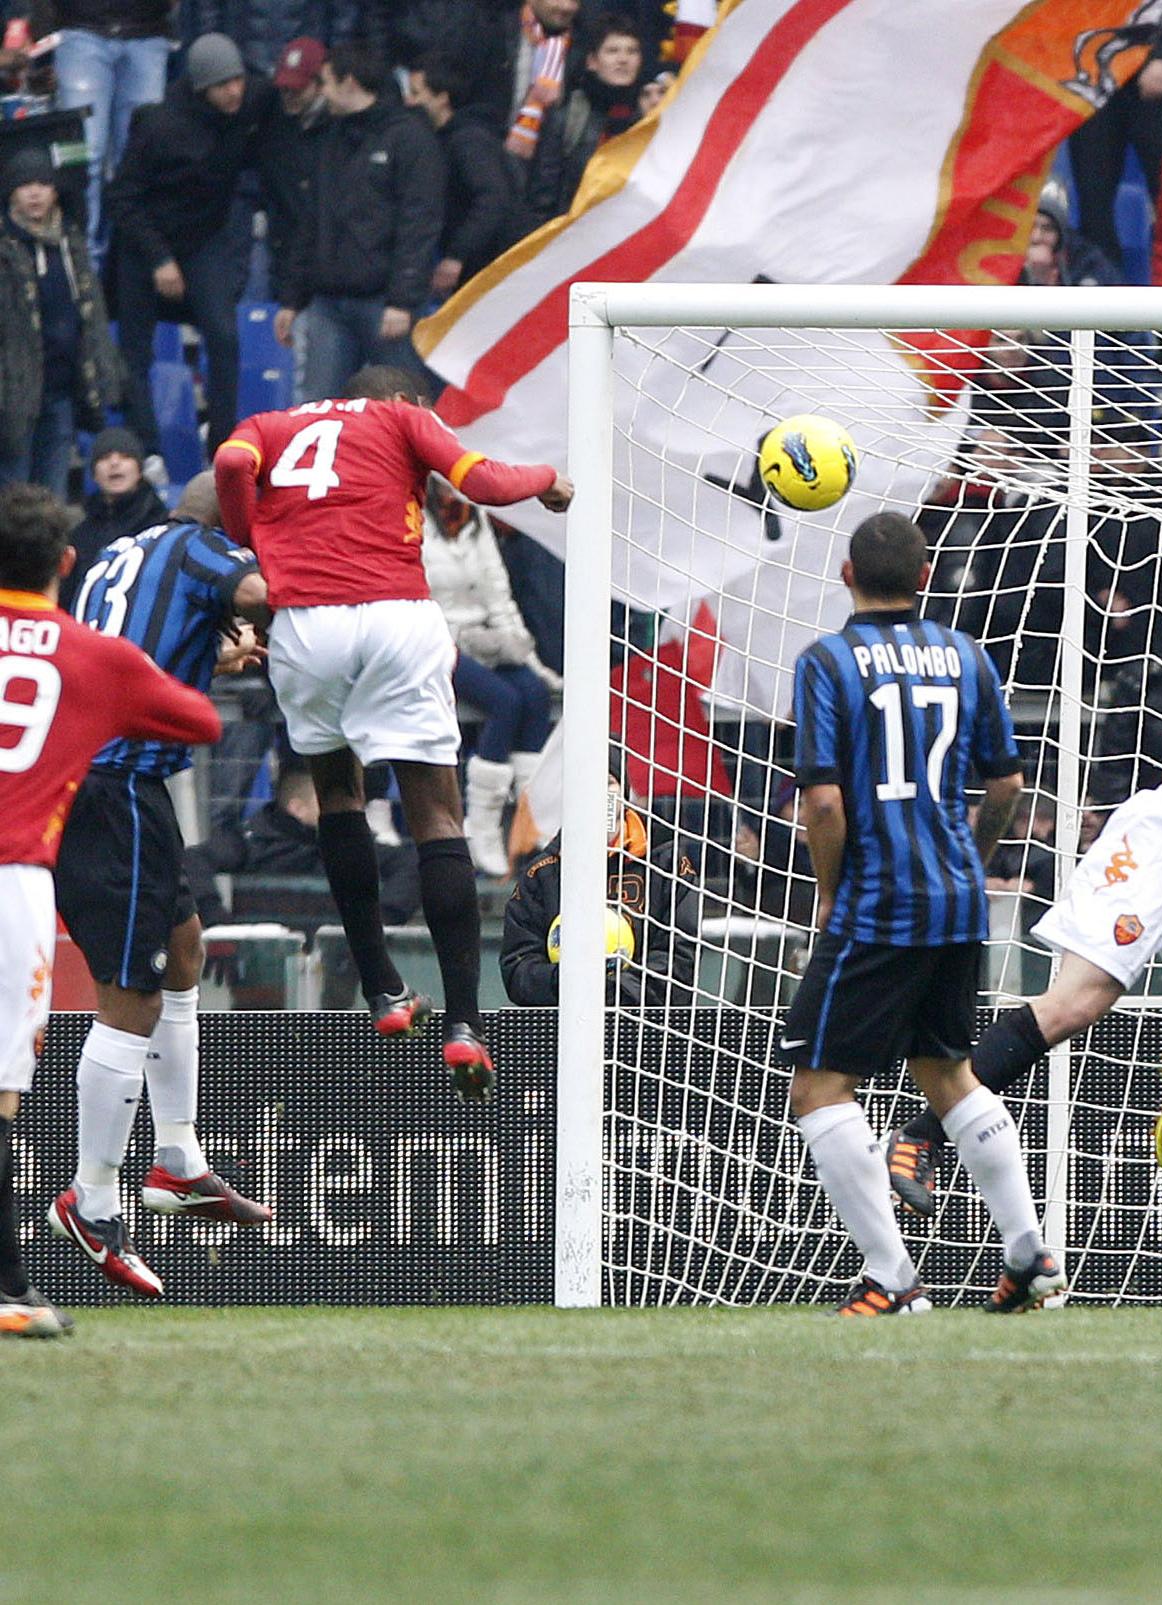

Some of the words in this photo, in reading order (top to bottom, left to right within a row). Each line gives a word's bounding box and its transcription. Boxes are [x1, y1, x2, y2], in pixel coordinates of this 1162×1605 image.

[270, 419, 343, 500] 4
[853, 643, 962, 678] PALOMBO
[0, 654, 62, 774] 9
[869, 682, 959, 803] 17
